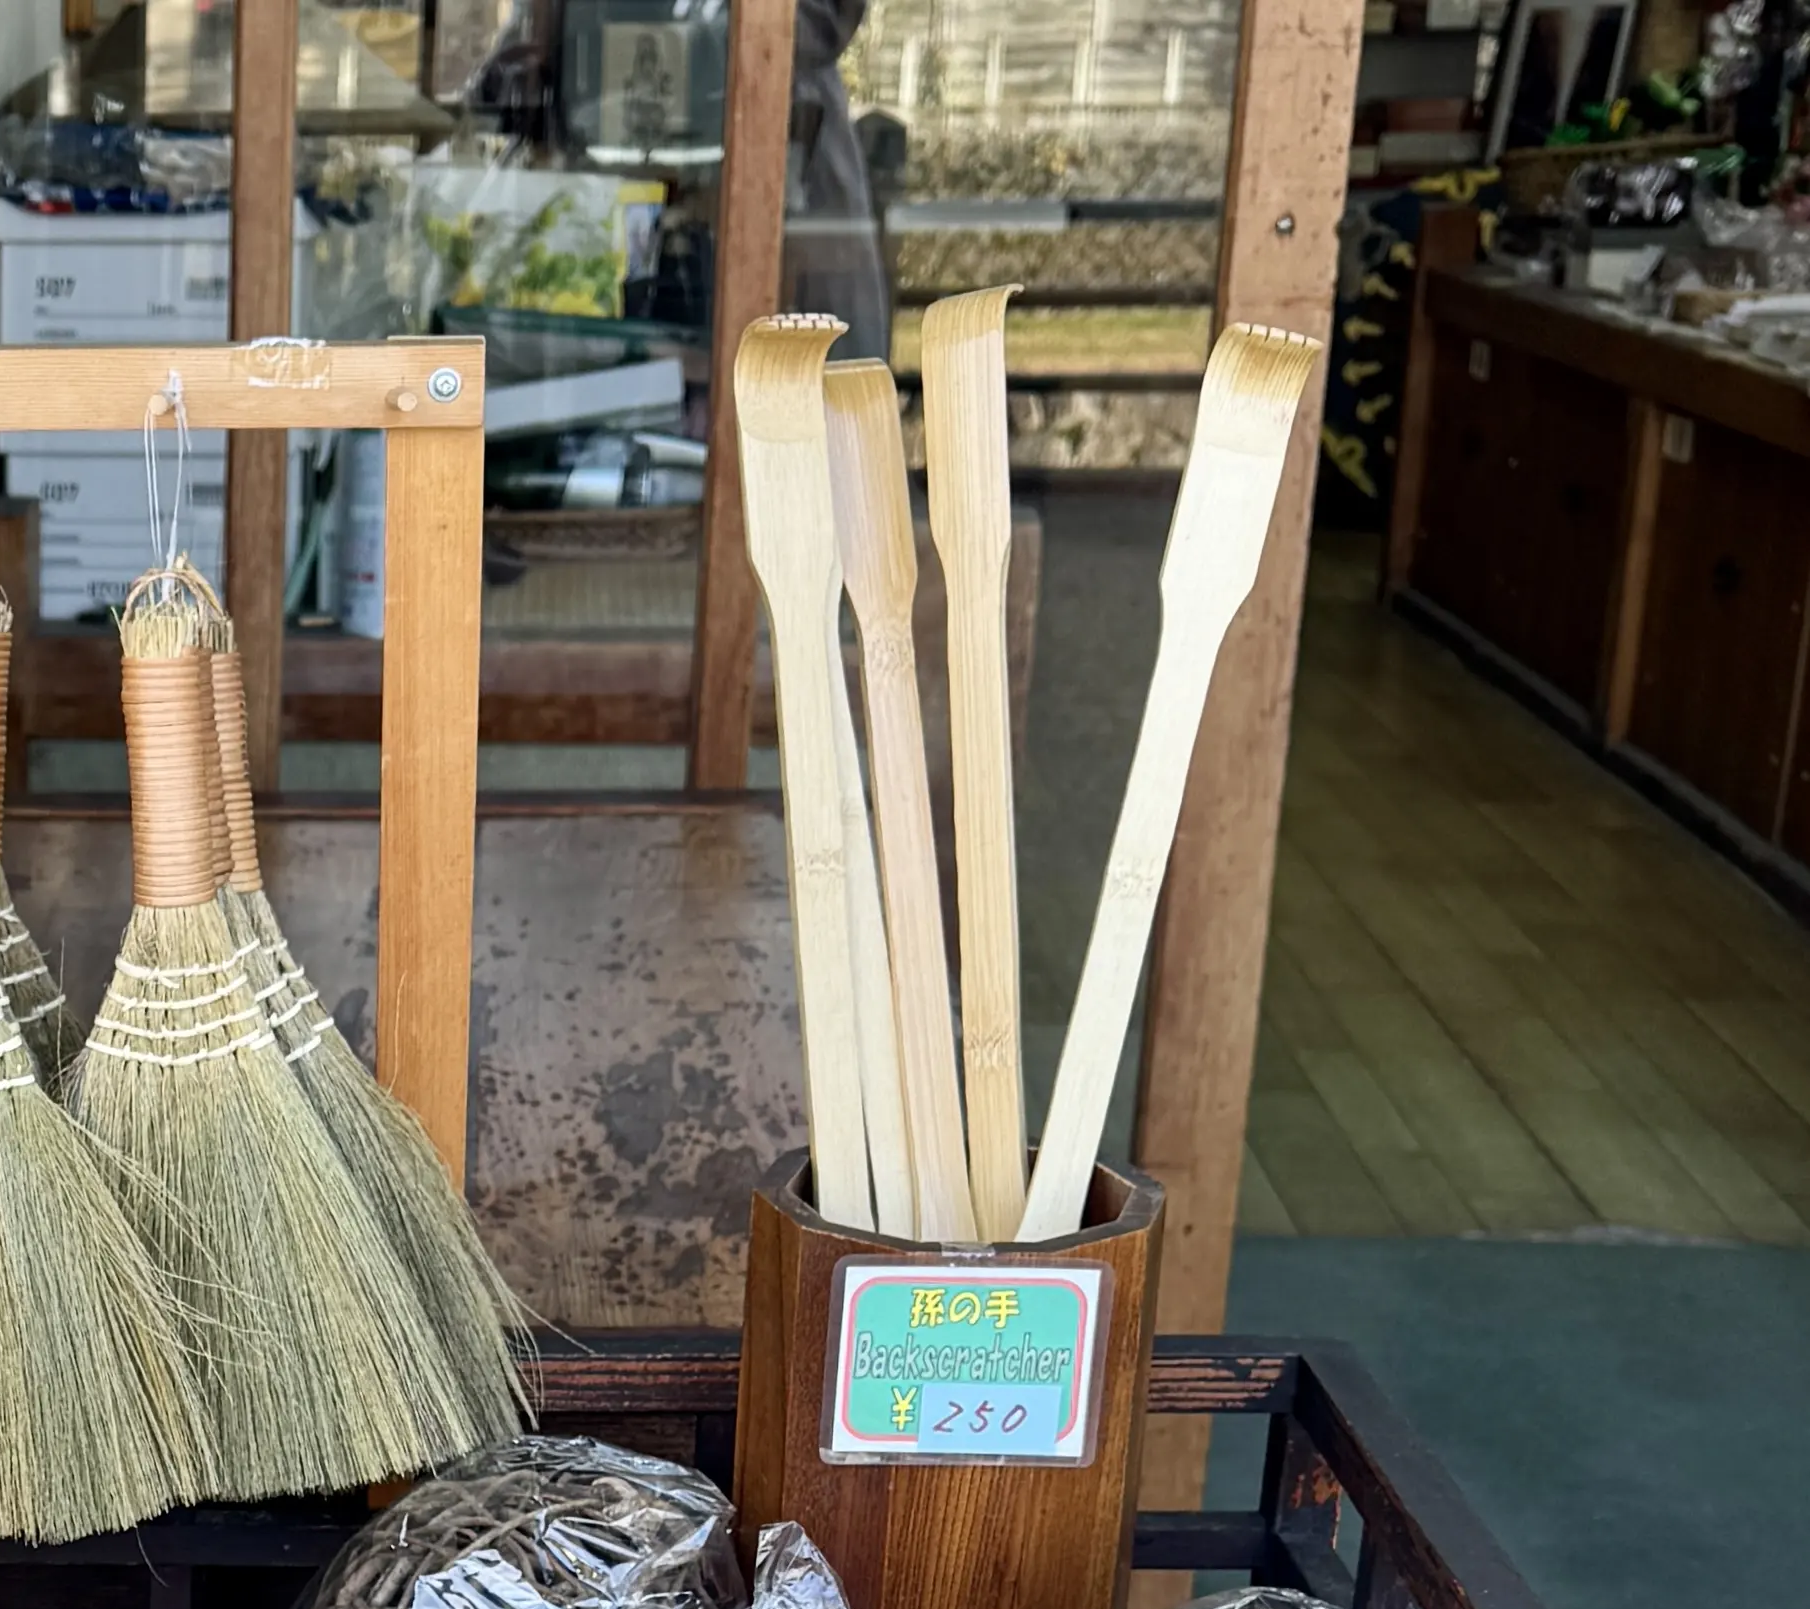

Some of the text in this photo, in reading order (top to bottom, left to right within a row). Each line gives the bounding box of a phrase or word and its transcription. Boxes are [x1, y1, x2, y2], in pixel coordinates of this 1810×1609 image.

[909, 1288, 1021, 1329] 孫の手
[852, 1330, 1071, 1382] Backscratcher
[932, 1399, 1028, 1434] 250
